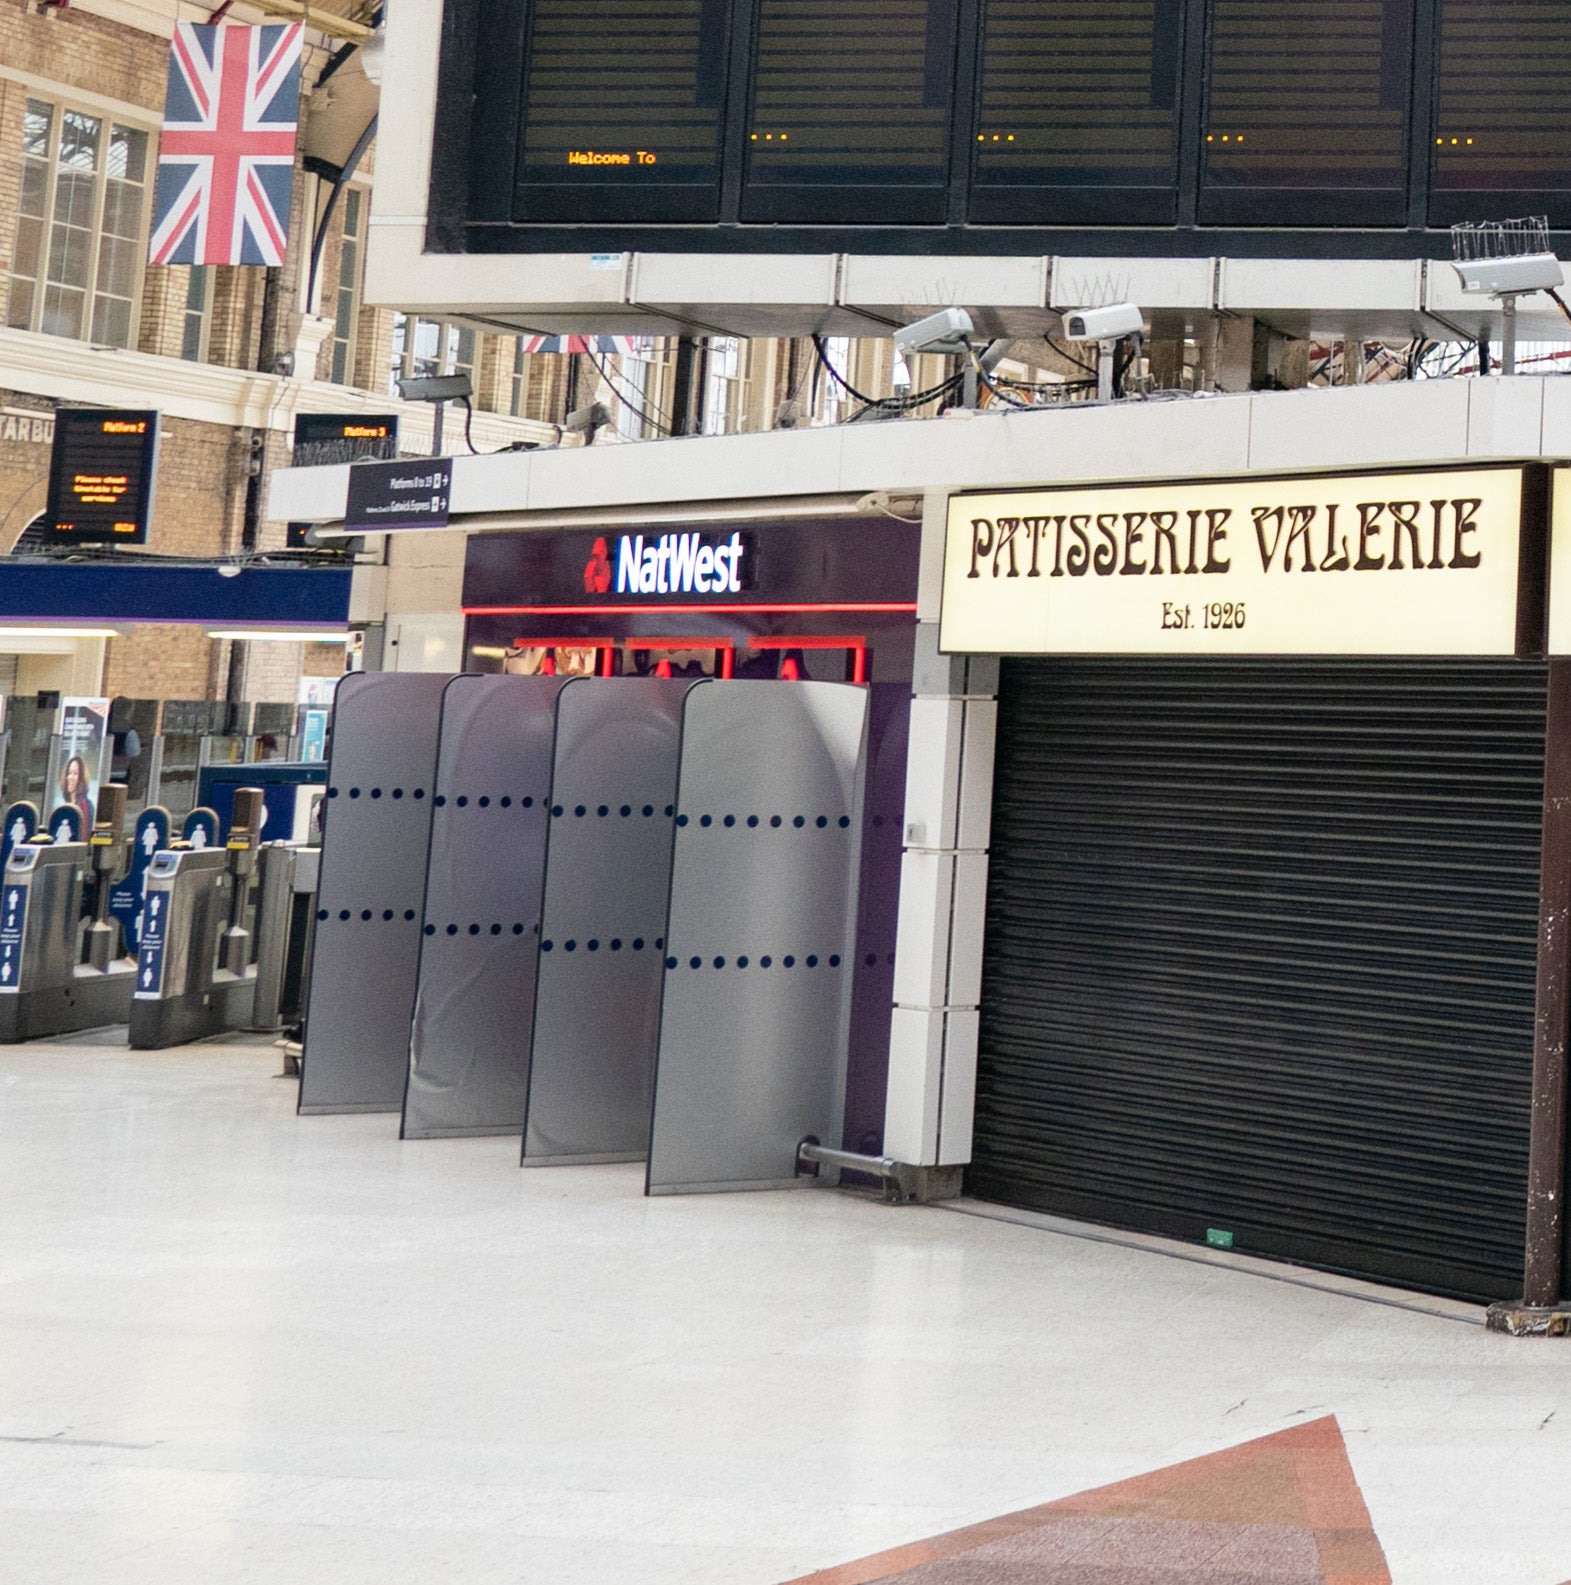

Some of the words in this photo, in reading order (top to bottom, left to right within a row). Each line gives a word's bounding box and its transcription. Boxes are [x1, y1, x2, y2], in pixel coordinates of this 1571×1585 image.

[618, 532, 743, 593] NatWest
[968, 509, 1232, 578] PATISSERIE
[1251, 499, 1481, 573] VALERIE
[1162, 603, 1196, 629] Est.
[1204, 603, 1245, 629] 1926
